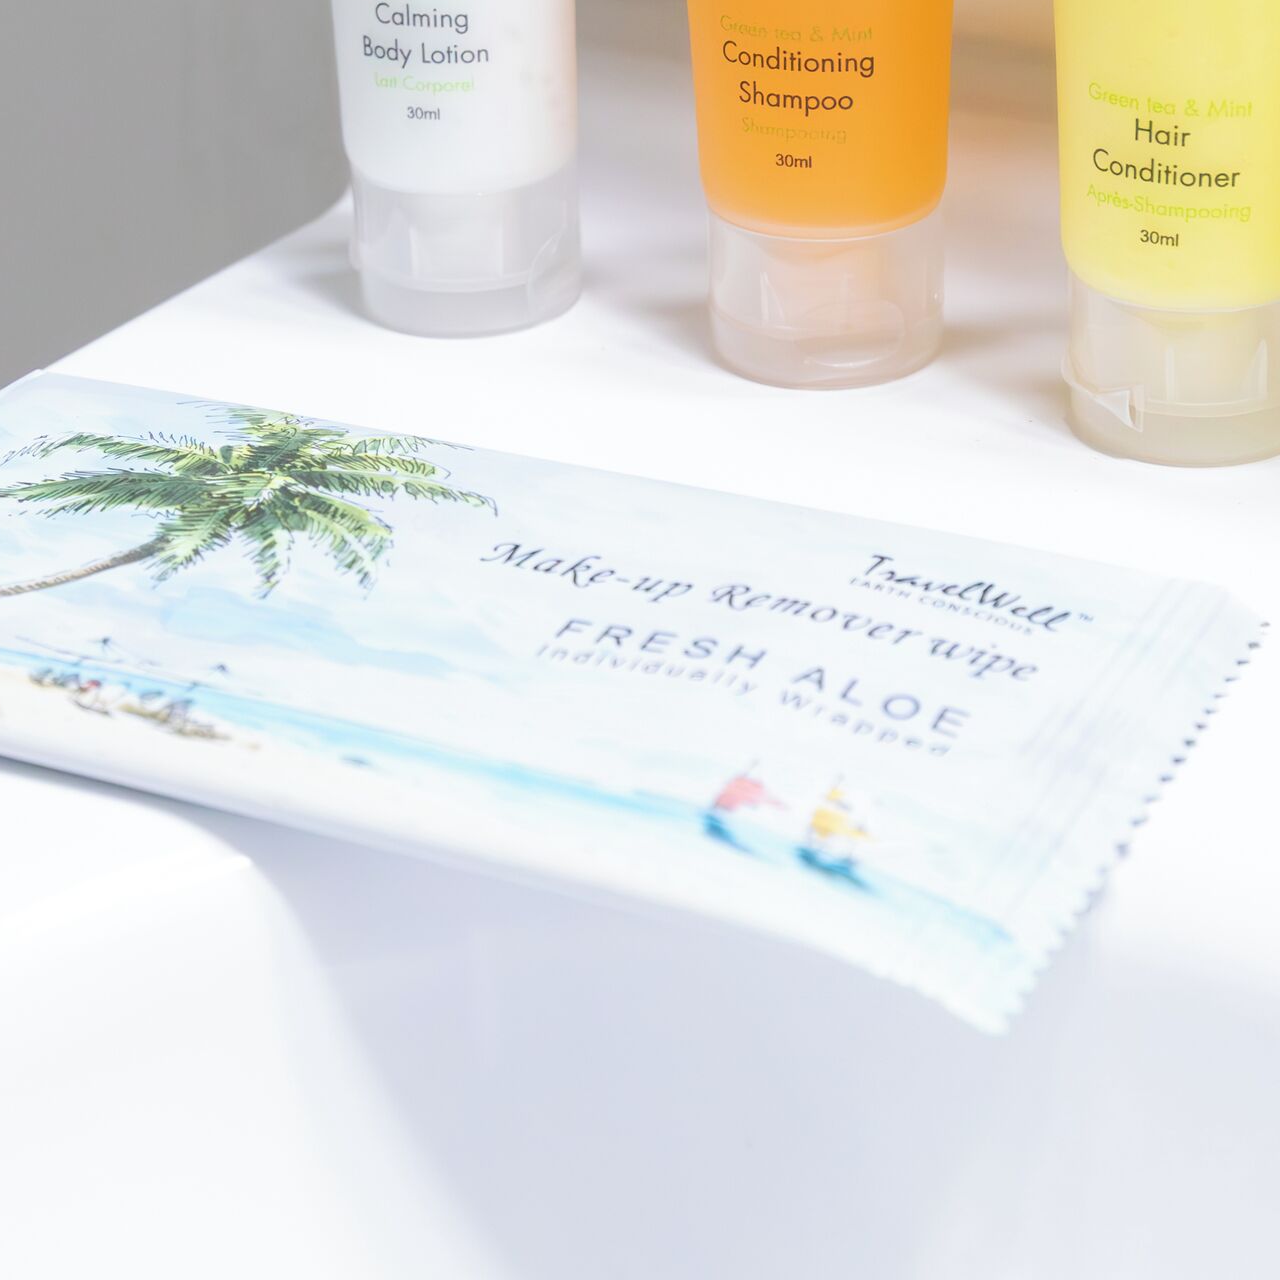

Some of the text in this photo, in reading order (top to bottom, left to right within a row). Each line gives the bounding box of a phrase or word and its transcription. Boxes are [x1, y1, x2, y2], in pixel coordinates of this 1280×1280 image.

[375, 2, 469, 34] Calming
[809, 26, 824, 42] &
[831, 27, 873, 42] Mint
[363, 35, 490, 69] Body Lotion
[722, 40, 875, 78] Conditioning
[407, 106, 441, 120] 30ml
[739, 80, 854, 117] Shampoo
[1088, 82, 1253, 118] Green tea & Mint
[1135, 118, 1191, 147] Hair
[775, 153, 812, 168] 30ml
[1093, 148, 1241, 188] Conditioner
[1140, 229, 1179, 247] 30ml
[480, 541, 1039, 681] Make-up Remover wipe
[850, 576, 1034, 635] EARTH CONSCIOUS
[555, 618, 971, 739] FRESH ALOE
[536, 643, 952, 757] Individually Wrapped
